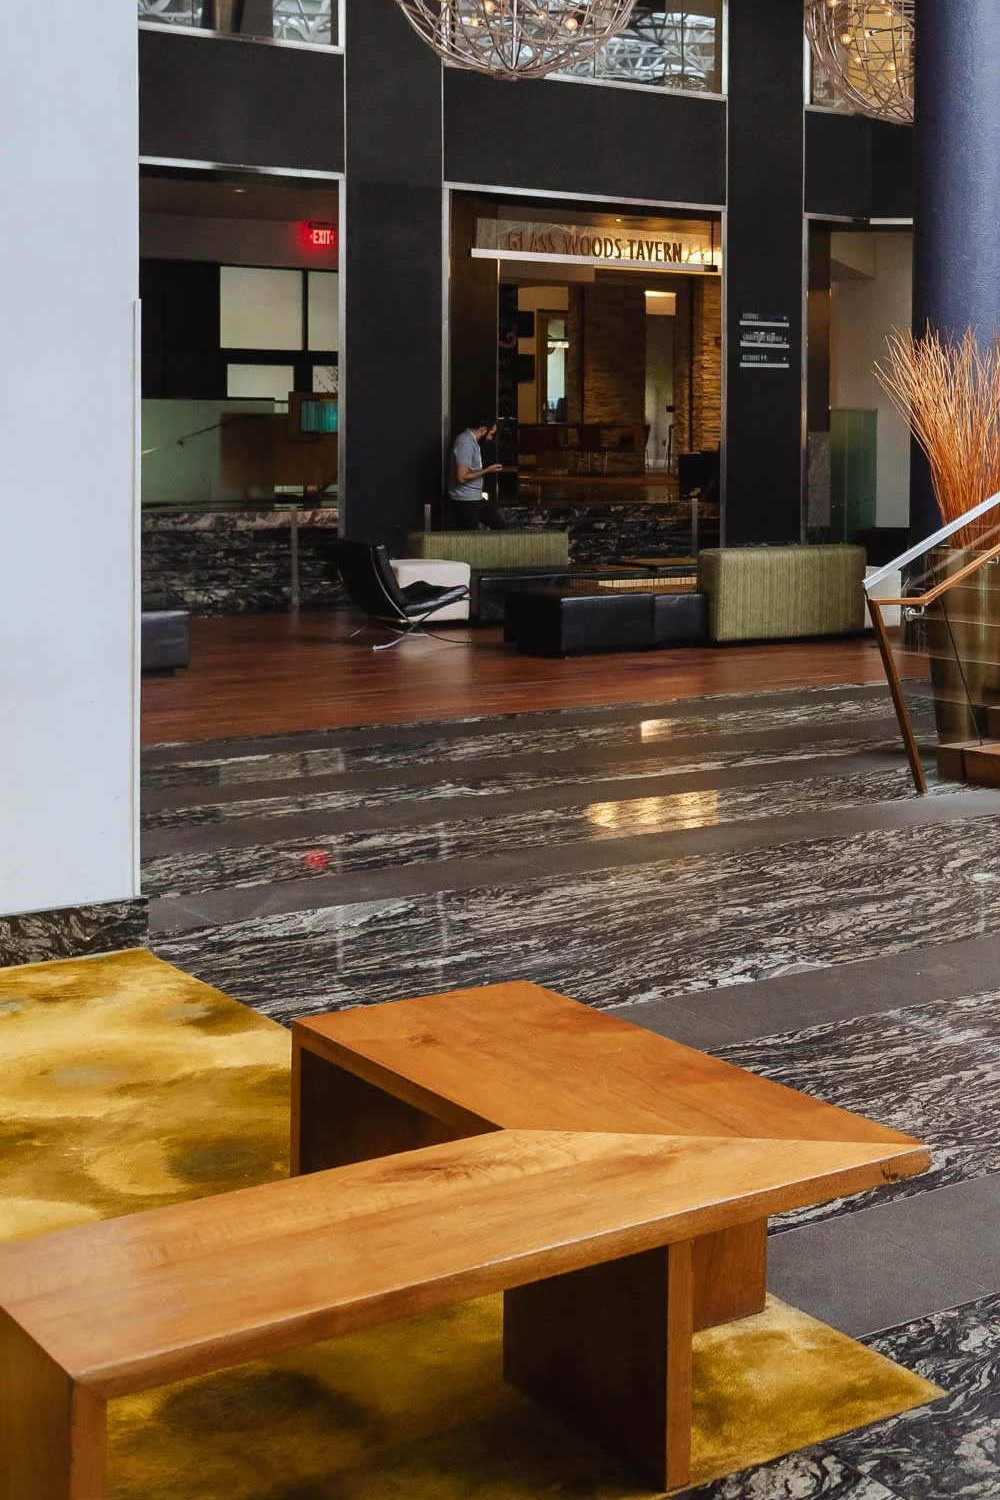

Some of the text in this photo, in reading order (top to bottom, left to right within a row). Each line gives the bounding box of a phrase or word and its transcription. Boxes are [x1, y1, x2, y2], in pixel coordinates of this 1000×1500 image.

[313, 230, 331, 244] EXIT
[508, 230, 682, 263] GLASS WOODS TAVERN
